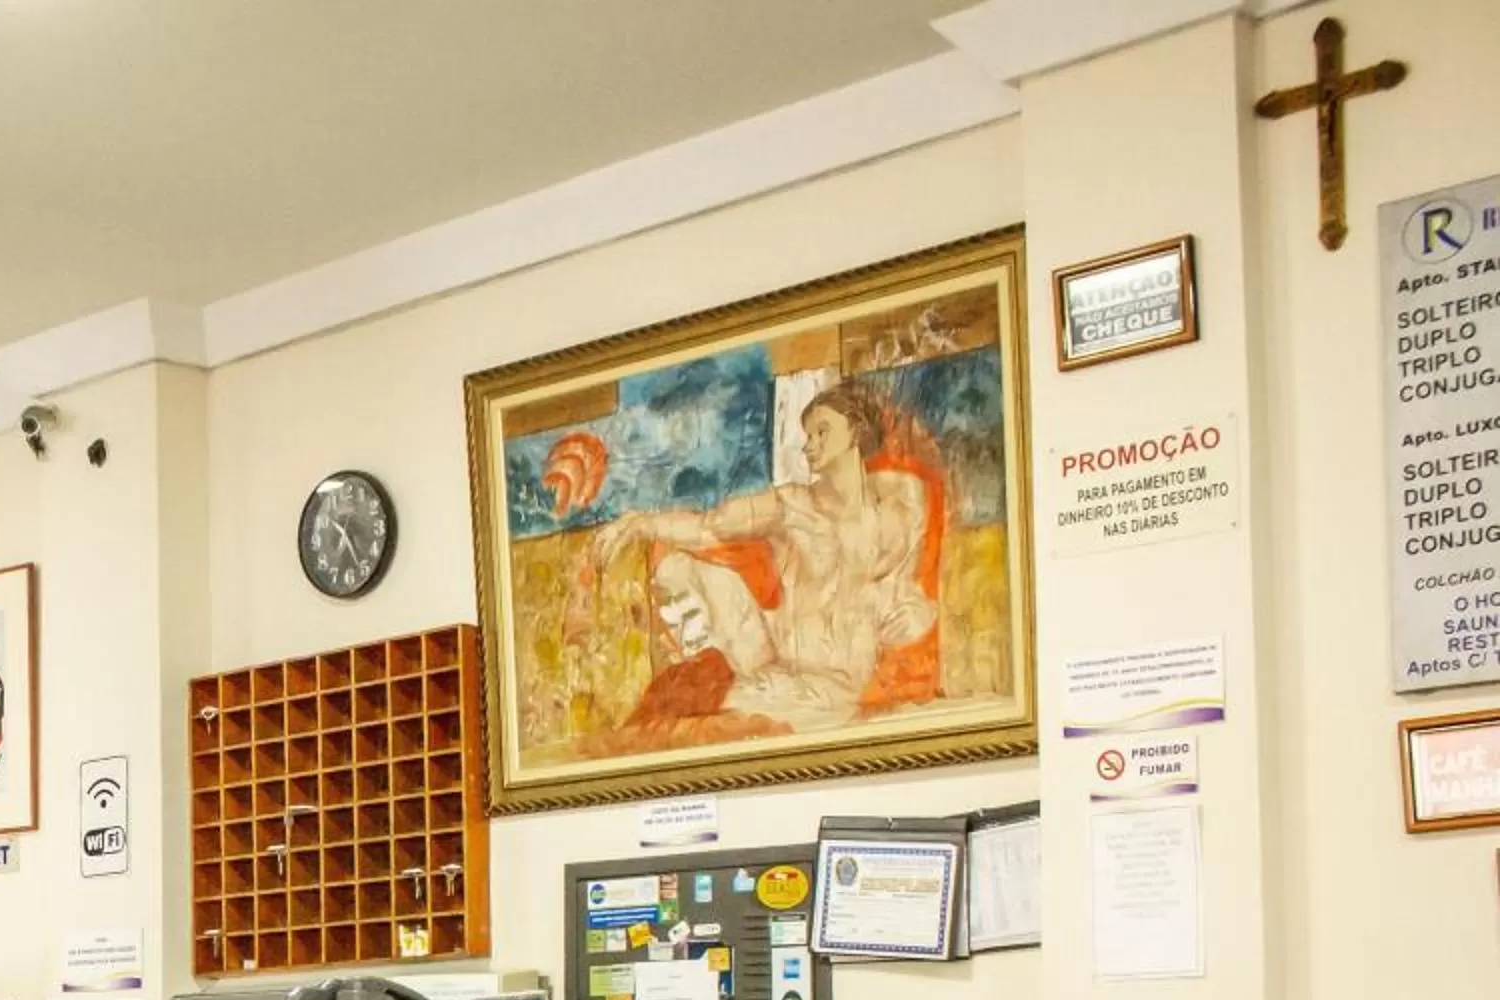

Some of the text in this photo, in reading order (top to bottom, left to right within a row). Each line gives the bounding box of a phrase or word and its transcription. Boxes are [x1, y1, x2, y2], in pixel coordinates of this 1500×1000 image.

[1398, 257, 1500, 294] Apto. STA
[1082, 306, 1173, 341] CHEQUE
[1398, 322, 1477, 354] DUPLO
[1398, 346, 1481, 378] TRIPLO
[1399, 368, 1500, 402] CONJUG
[1061, 426, 1221, 478] PROMOÇÃO
[1402, 431, 1449, 447] Apto.
[1077, 466, 1207, 503] PARA PAGAMENTO EM
[1404, 477, 1482, 507] DUPLO
[1057, 481, 1229, 527] DINHEIRO 10% DE DESCONTO
[1404, 502, 1487, 530] TRIPLO
[1103, 511, 1179, 537] NAS DIARIAS
[1454, 597, 1469, 612] O
[1407, 657, 1461, 677] Aptos
[1131, 743, 1190, 759] PROIBIDO
[1139, 762, 1181, 776] FUMAR
